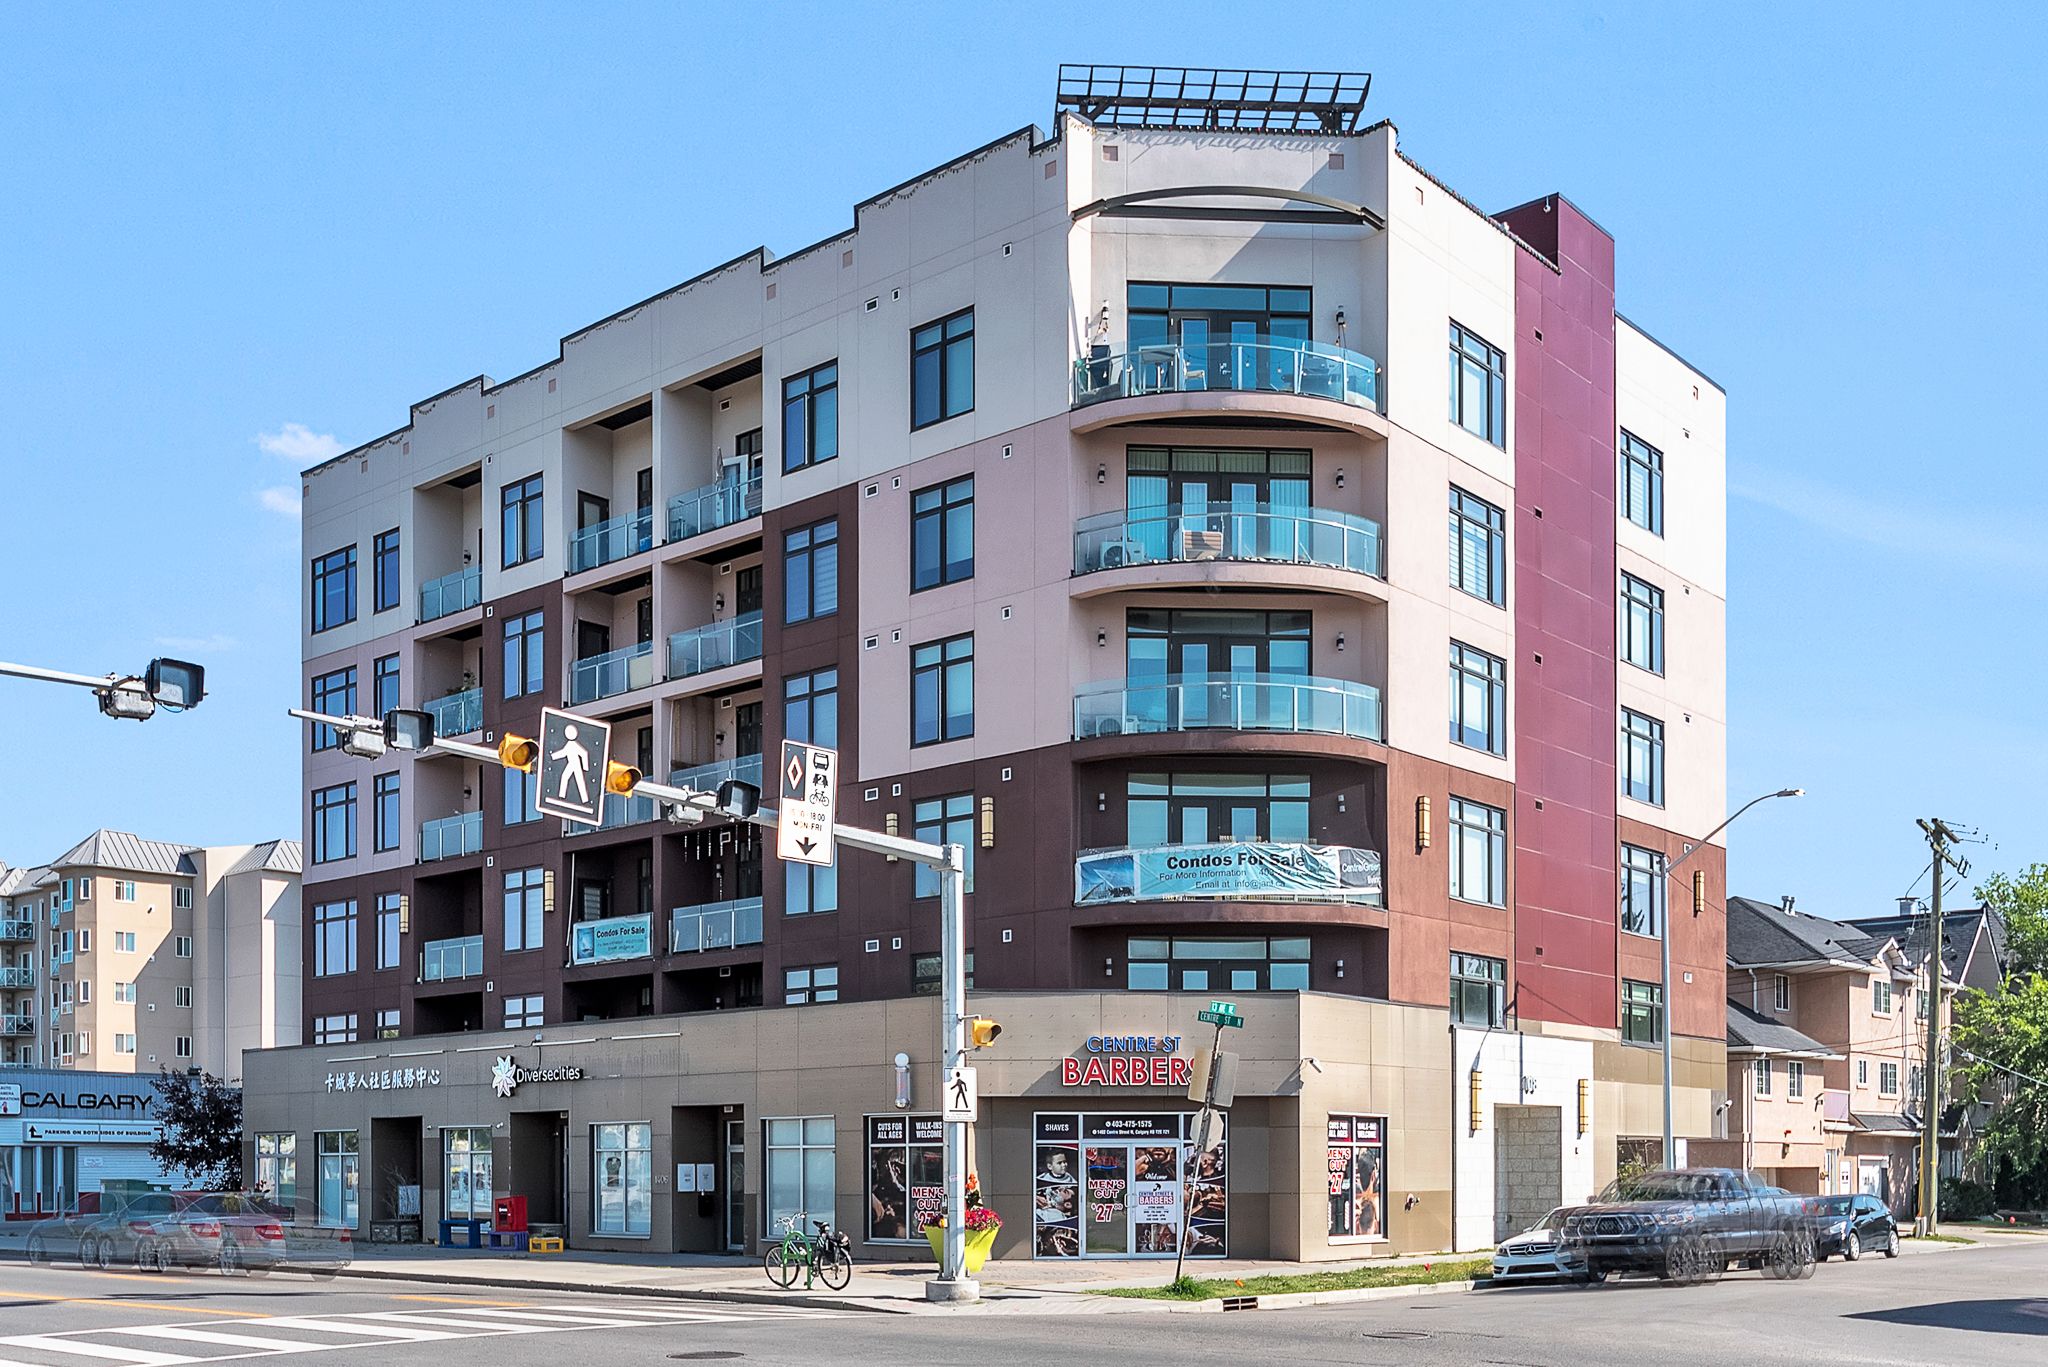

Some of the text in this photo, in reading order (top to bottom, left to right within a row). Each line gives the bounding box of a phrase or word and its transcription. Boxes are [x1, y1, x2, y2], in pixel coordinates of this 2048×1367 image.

[1167, 852, 1305, 870] Condos For Sale
[1159, 869, 1247, 881] For More Information
[1195, 880, 1220, 889] Email
[1221, 880, 1230, 889] at
[596, 926, 646, 938] Condos For Sale
[1200, 1012, 1242, 1027] CENTRE ST N
[1086, 1036, 1182, 1053] CENTRE ST
[516, 1065, 581, 1084] Diversecities
[21, 1092, 153, 1111] CALGARY
[877, 1122, 903, 1131] CUTS FOR
[915, 1121, 943, 1130] WALK-INS
[1045, 1123, 1070, 1132] SHAVES
[877, 1131, 903, 1139] ALL AGES
[915, 1130, 943, 1139] WELCOME
[1329, 1159, 1348, 1172] CUT
[1088, 1179, 1126, 1190] MEN'S
[911, 1186, 945, 1199] MEN'S
[1093, 1189, 1120, 1199] CUT
[916, 1198, 941, 1210] CUT
[1138, 1196, 1174, 1205] BARBERS
